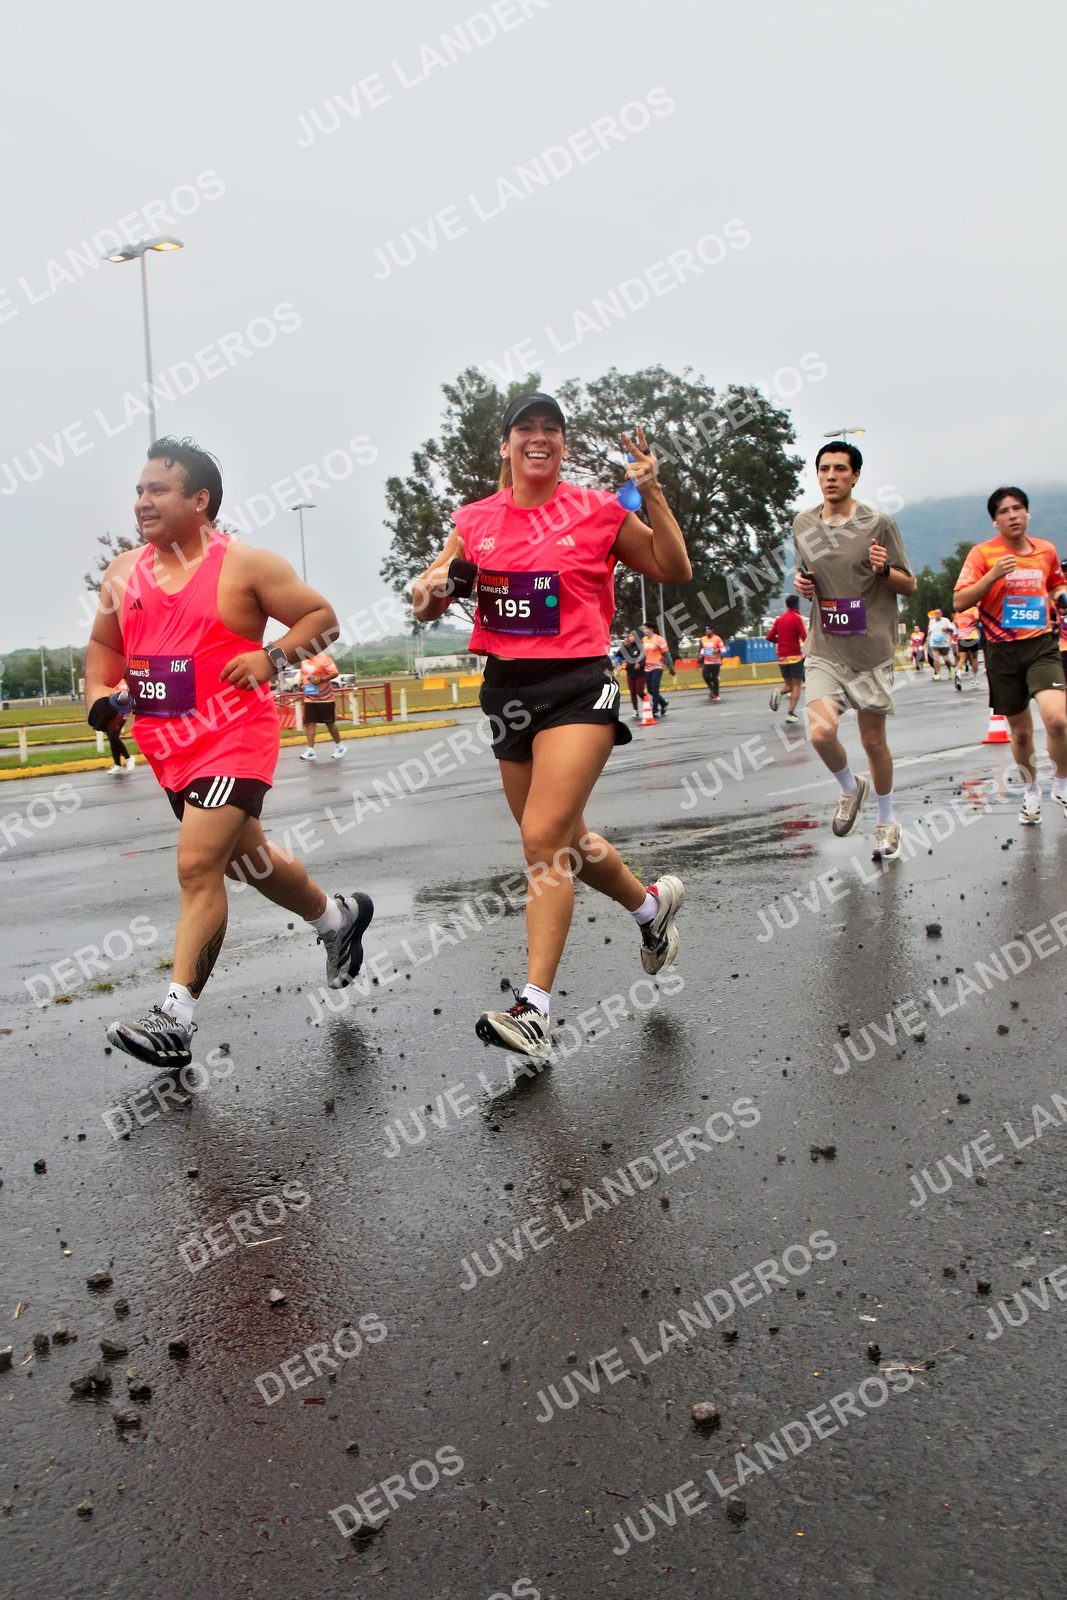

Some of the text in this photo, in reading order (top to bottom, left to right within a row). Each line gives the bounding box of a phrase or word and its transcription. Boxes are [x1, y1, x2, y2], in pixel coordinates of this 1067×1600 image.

[494, 599, 531, 617] 195
[1012, 610, 1039, 620] 2568
[828, 613, 848, 624] 710
[138, 681, 166, 700] 298
